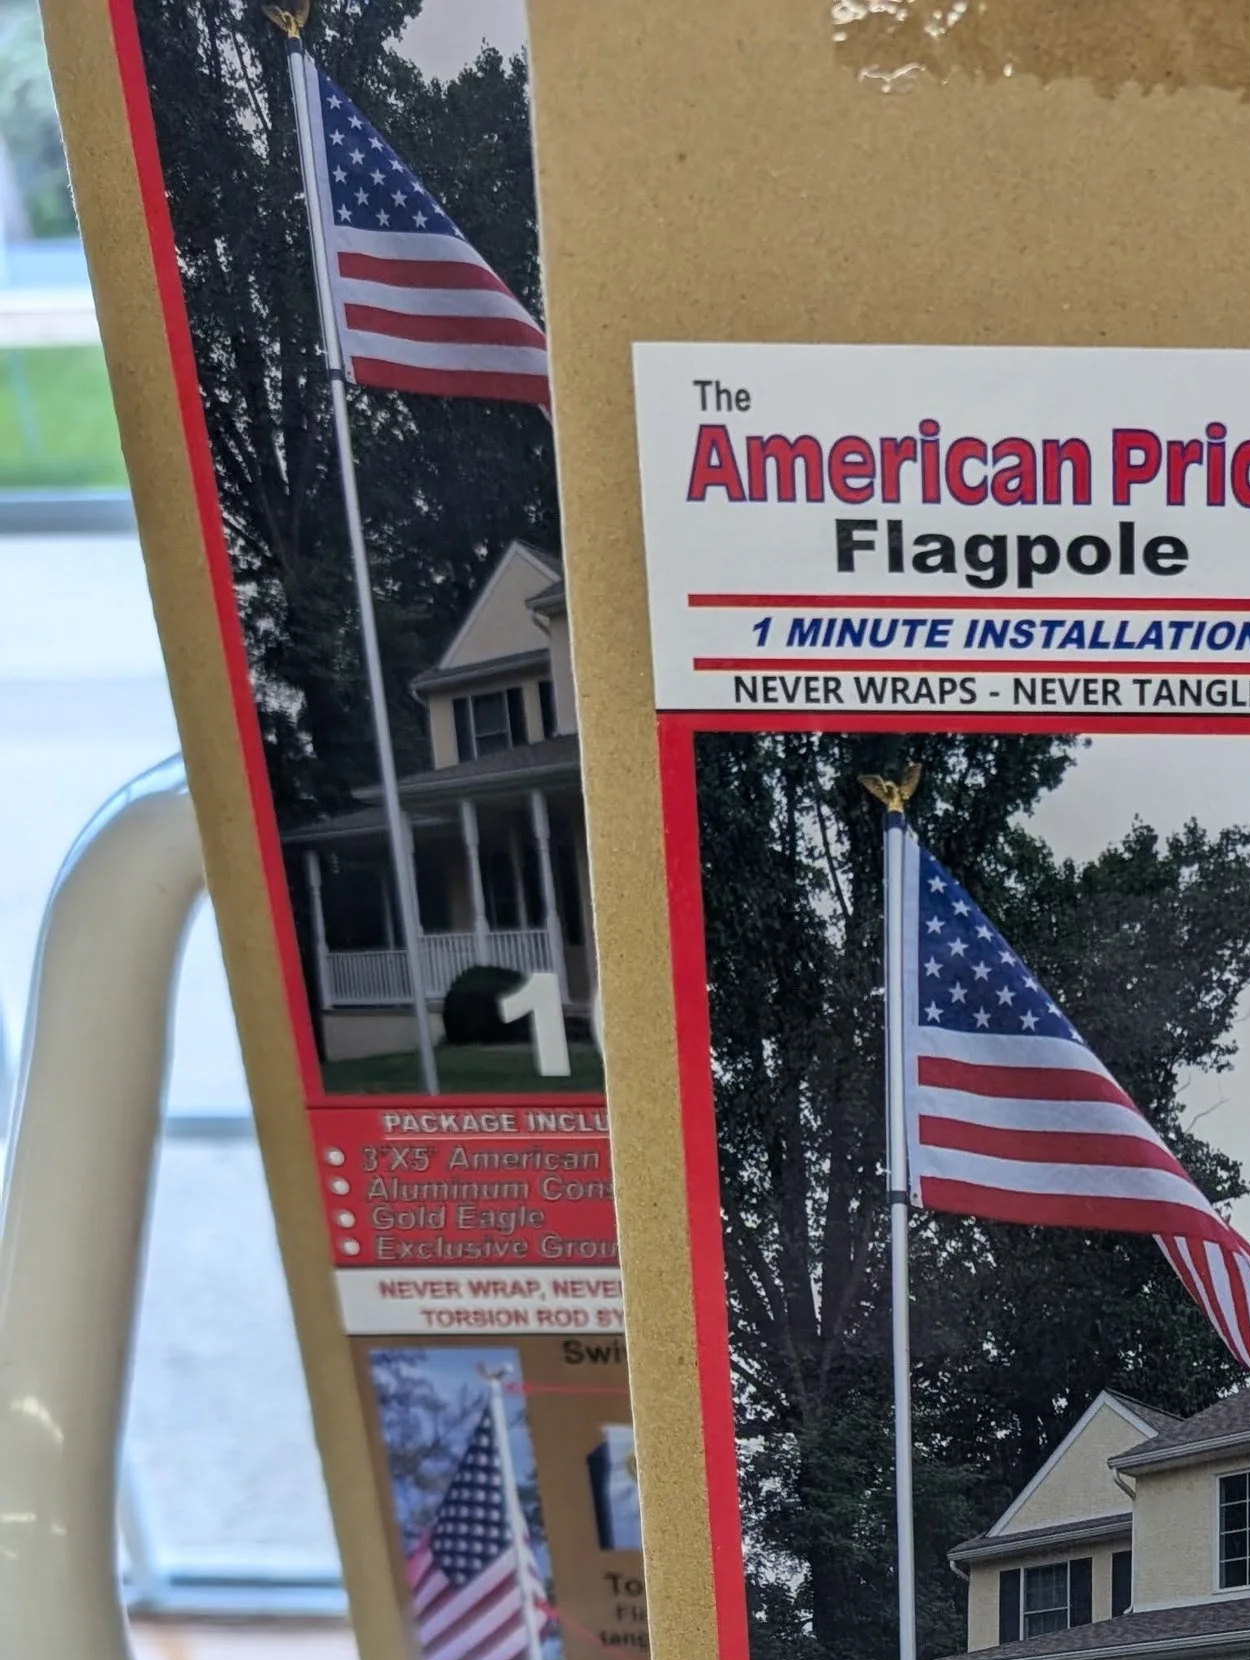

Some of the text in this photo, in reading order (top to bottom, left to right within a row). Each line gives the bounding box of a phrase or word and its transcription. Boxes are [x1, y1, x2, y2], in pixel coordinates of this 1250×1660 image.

[693, 380, 752, 412] The
[686, 418, 1092, 506] American
[835, 519, 1190, 589] Flagpole
[750, 617, 772, 648] 1
[787, 617, 953, 649] MINUTE
[733, 675, 843, 705] NEVER
[854, 677, 977, 705] WRAPS
[1012, 678, 1123, 706] NEVER
[384, 1112, 609, 1133] PACKAGE INCLU
[449, 1145, 599, 1170] American
[368, 1177, 529, 1201] Aluminum
[372, 1204, 545, 1234] Gold Eagle
[376, 1235, 528, 1260] Exclusive
[379, 1280, 461, 1297] NEVER
[553, 1281, 623, 1298] NEVE
[421, 1309, 529, 1326] TORSION
[538, 1309, 588, 1326] ROD
